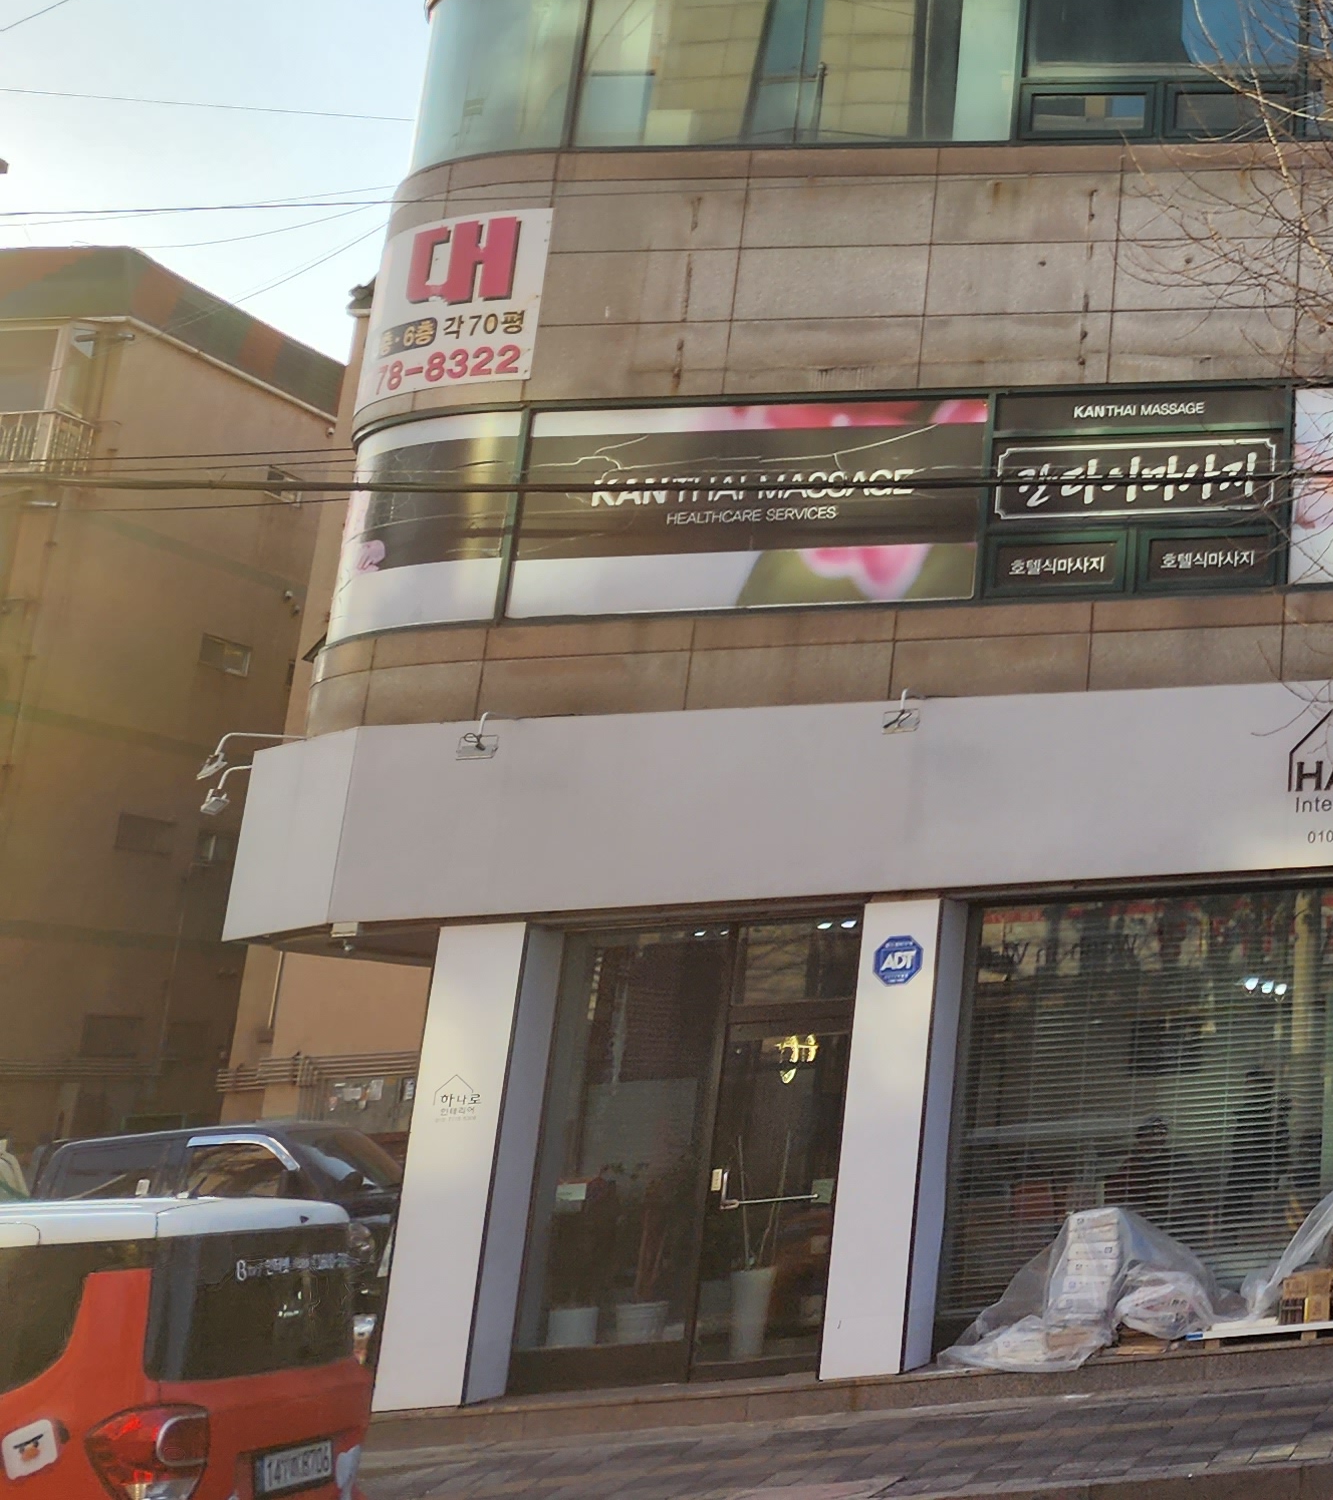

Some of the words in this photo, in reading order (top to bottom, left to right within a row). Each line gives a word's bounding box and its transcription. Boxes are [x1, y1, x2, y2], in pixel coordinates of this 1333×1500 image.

[1140, 401, 1205, 416] MASSAGE
[666, 509, 761, 525] HEALTHCARE
[765, 505, 838, 521] SERVICES
[1009, 556, 1105, 576] 호텔식마사지
[1160, 550, 1255, 570] 호텔식마사지
[880, 949, 917, 971] ADT
[440, 1093, 482, 1107] 하나로
